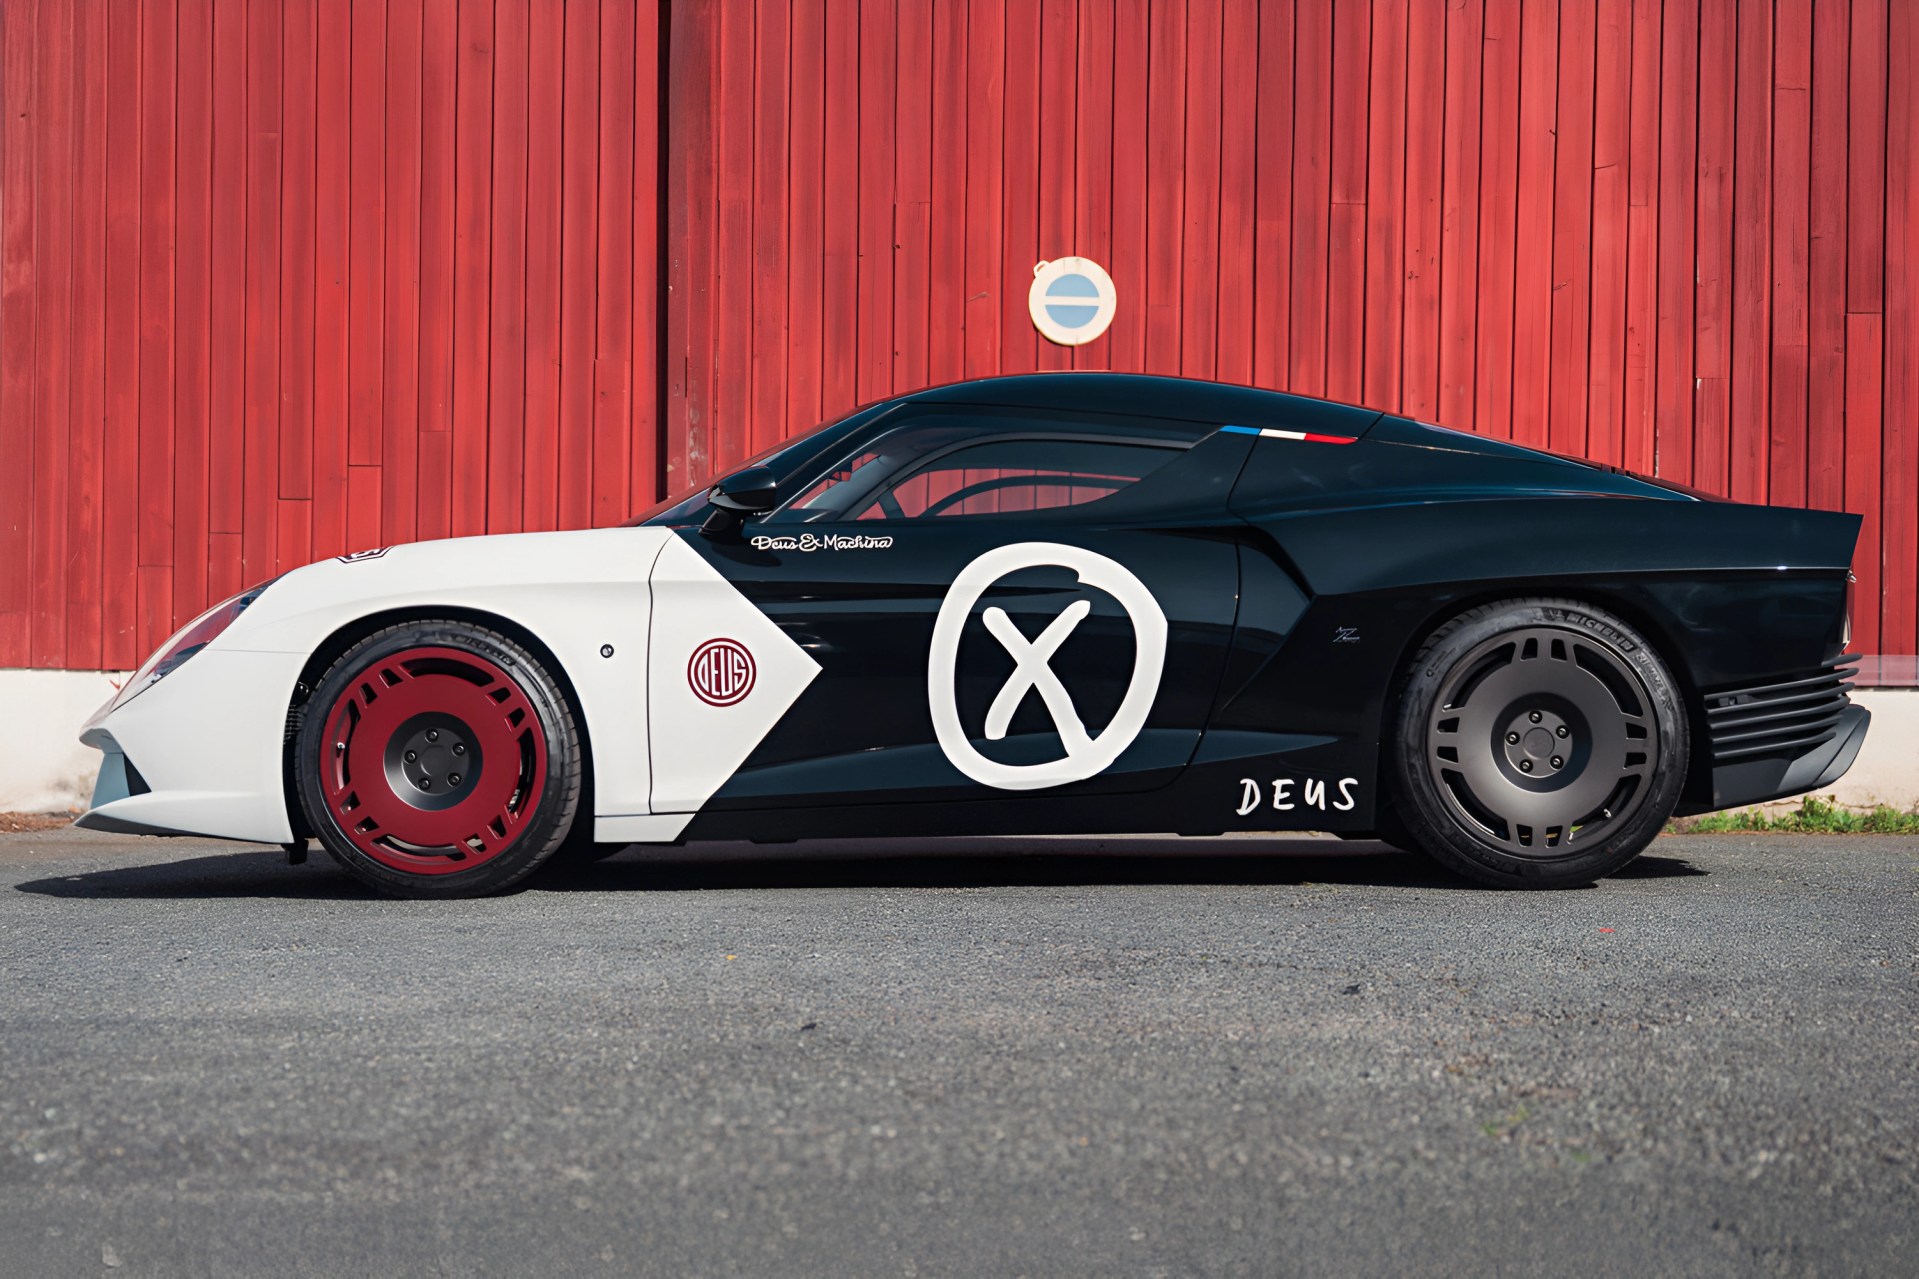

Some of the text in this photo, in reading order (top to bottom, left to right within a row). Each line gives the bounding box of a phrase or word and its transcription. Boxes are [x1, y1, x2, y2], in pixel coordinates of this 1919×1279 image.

[750, 535, 799, 550] Deus
[824, 534, 894, 551] Machina
[1566, 613, 1634, 652] MICHELIN
[697, 648, 747, 697] DEUS
[1236, 777, 1359, 816] DEUS
